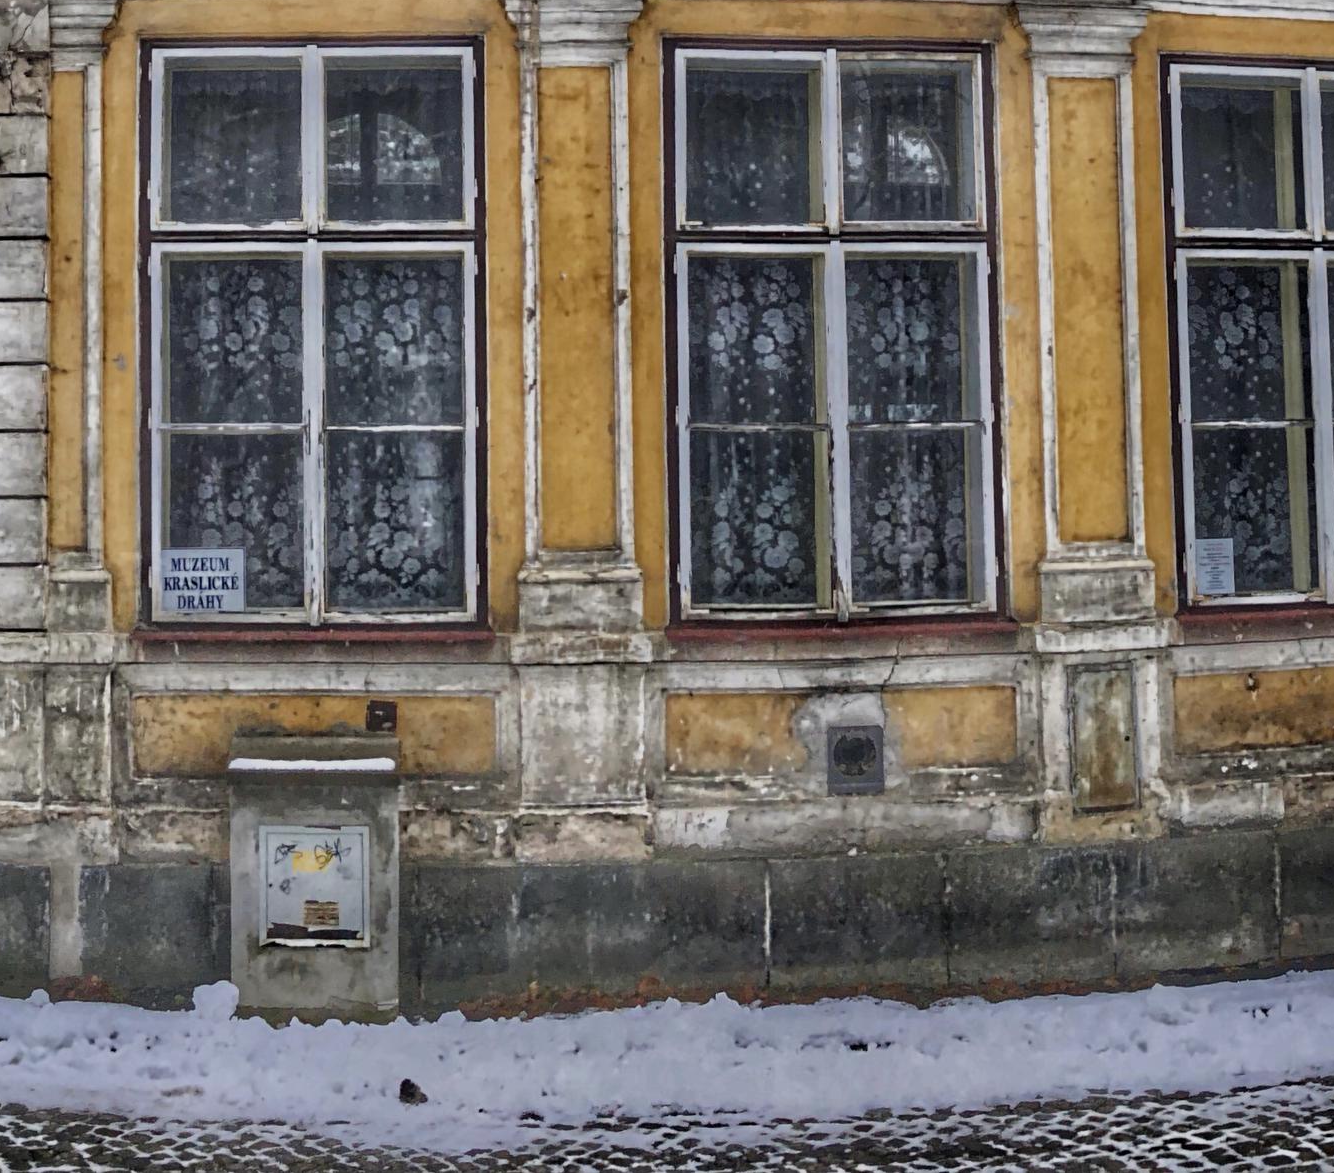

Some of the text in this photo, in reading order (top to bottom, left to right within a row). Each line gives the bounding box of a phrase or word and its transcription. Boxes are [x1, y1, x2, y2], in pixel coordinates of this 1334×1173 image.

[170, 557, 231, 572] MUZEUM
[163, 572, 240, 591] KRASLICKÉ
[177, 591, 224, 609] DRÁHY
